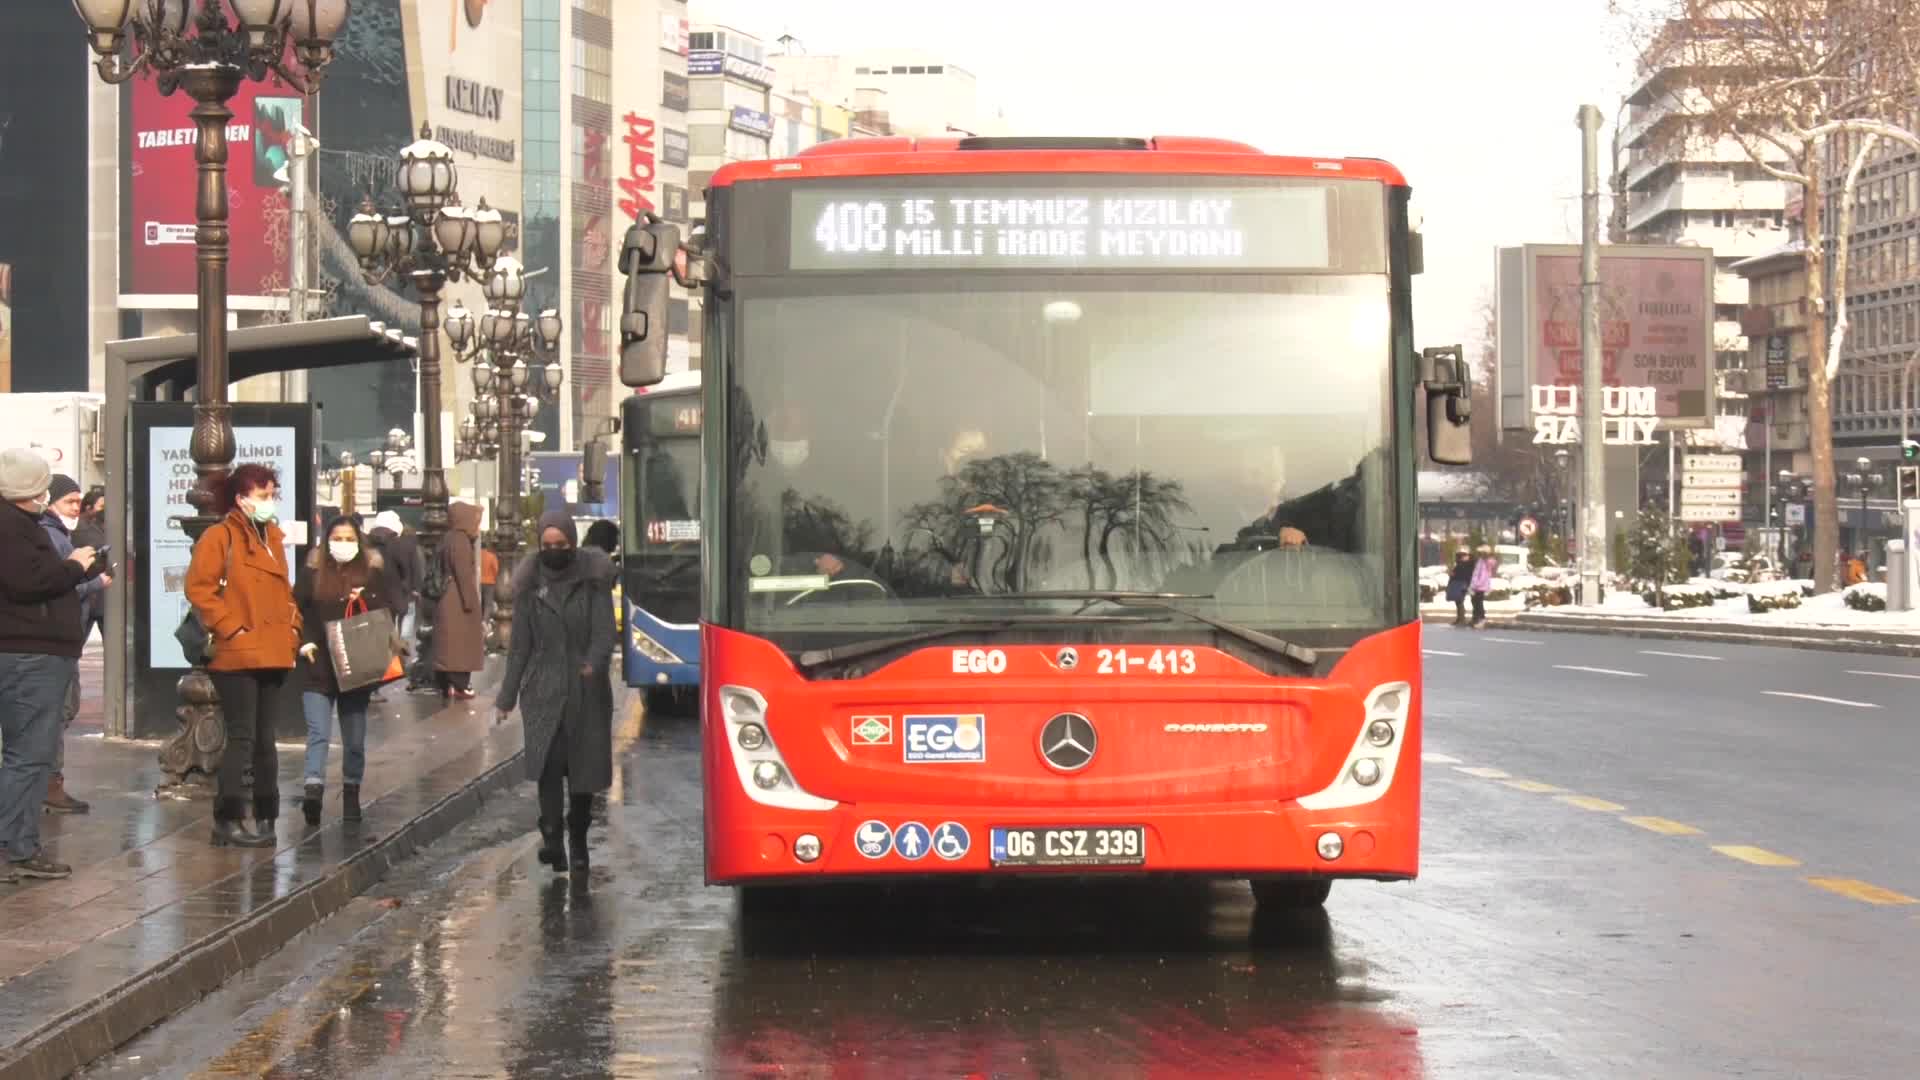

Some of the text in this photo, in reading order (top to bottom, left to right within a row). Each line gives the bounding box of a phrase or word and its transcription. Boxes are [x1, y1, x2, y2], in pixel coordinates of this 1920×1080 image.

[446, 75, 503, 122] KIZILAY
[902, 199, 1232, 224] 15 TEMMUZ KIZILAY
[814, 201, 886, 252] 408
[1100, 229, 1242, 256] MEYDANI
[648, 521, 665, 540] 413
[952, 649, 1007, 673] EGO
[1097, 648, 1196, 674] 21-413
[908, 723, 980, 751] EGO
[1007, 830, 1138, 856] 06 CSZ 339
